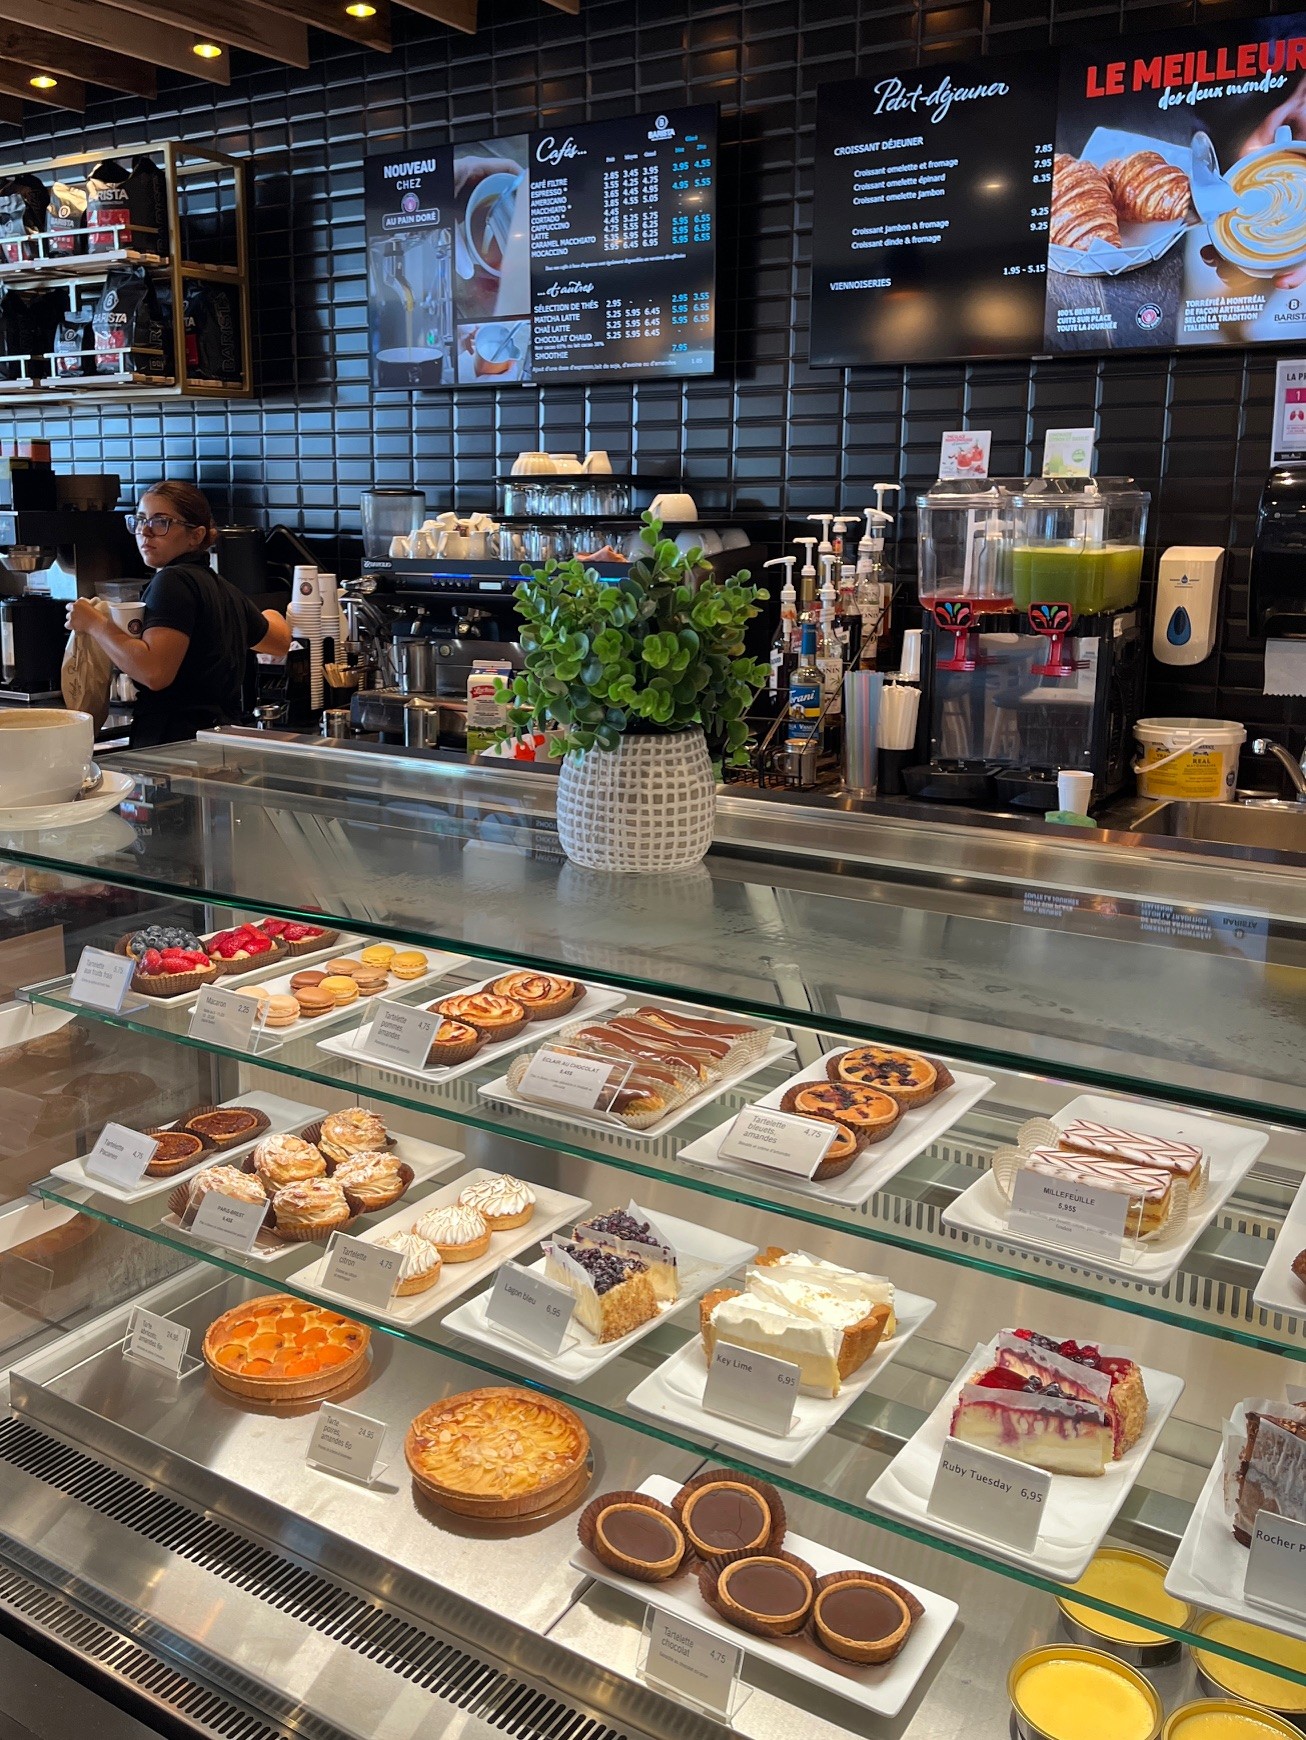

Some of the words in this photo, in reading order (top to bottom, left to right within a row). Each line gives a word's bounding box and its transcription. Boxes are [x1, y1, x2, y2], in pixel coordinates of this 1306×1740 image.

[1086, 62, 1126, 98] LE
[1132, 37, 1306, 92] MEILLEUR
[1158, 86, 1186, 110] des
[1186, 82, 1223, 106] deux
[1226, 68, 1288, 96] mondes
[834, 142, 880, 156] CROISSANT
[882, 136, 924, 150] DÉJEUNER
[383, 158, 436, 178] NOUVEAU
[531, 179, 546, 189] CAFÉ
[547, 178, 568, 188] FILTRE
[623, 169, 639, 178] 3.45
[642, 166, 659, 175] 3.95
[672, 162, 689, 172] 3.95
[853, 181, 885, 191] Croissant
[886, 178, 917, 188] omelette
[918, 173, 946, 185] épinard
[1034, 159, 1052, 169] 7.95
[854, 167, 886, 178] Croissant
[887, 163, 918, 174] omelette
[928, 159, 958, 169] fromage
[396, 178, 421, 190] CHEZ
[531, 188, 562, 198] ESPRESSO
[623, 178, 639, 186] 4.25
[642, 176, 659, 184] 4.75
[853, 195, 885, 205] Croissant
[885, 192, 917, 202] omelette
[917, 189, 945, 199] jambon
[1033, 174, 1051, 183] 8.35
[531, 197, 567, 207] AMERICANO
[623, 187, 639, 196] 4.45
[642, 185, 659, 193] 4.95
[531, 206, 566, 216] MACCHIATO
[386, 218, 397, 226] AU
[398, 215, 414, 225] PAIN
[416, 212, 436, 222] DORÉ
[531, 215, 560, 224] CORTADO
[852, 226, 883, 236] Croissant
[884, 224, 911, 234] jambon
[919, 220, 949, 229] fromage
[1031, 207, 1049, 216] 9.25
[531, 222, 570, 232] CAPPUCCINO
[531, 232, 549, 240] LATTE
[531, 240, 559, 249] CARAMEL
[560, 236, 596, 246] MACCHIATO
[851, 240, 883, 249] Croissant
[884, 238, 903, 246] dinde
[911, 235, 941, 244] fromage
[1030, 222, 1048, 231] 9.25
[531, 248, 568, 258] MOCACCINO
[642, 238, 659, 247] 6.95
[829, 277, 892, 291] VIENNOISERIES
[1003, 266, 1020, 275] 1.95
[1028, 264, 1046, 273] 5.15
[534, 304, 569, 313] SÉLECTION
[581, 300, 599, 309] THÉS
[606, 299, 622, 308] 2.95
[672, 294, 688, 303] 2.95
[693, 292, 709, 300] 3.55
[1186, 298, 1219, 307] TORRÉFIÉ
[1220, 297, 1226, 306] À
[1227, 294, 1266, 305] MONTRÉAL
[534, 315, 560, 323] MATCHA
[606, 310, 622, 318] 5.25
[625, 309, 641, 317] 5.95
[644, 307, 660, 316] 6.45
[672, 305, 688, 314] 5.95
[1074, 307, 1100, 316] BEURRE
[1220, 304, 1263, 313] ARTISANALE
[93, 313, 127, 323] BARISTA
[606, 321, 622, 329] 5.25
[625, 319, 641, 328] 5.95
[644, 318, 660, 326] 6.45
[672, 316, 688, 325] 5.95
[1218, 313, 1258, 322] TRADITION
[1088, 321, 1117, 330] JOURNÉE
[1184, 323, 1219, 332] ITALIENNE
[534, 335, 568, 344] CHOCOLAT
[606, 331, 622, 339] 5.25
[625, 330, 641, 338] 5.95
[644, 329, 660, 337] 6.45
[535, 352, 568, 360] SMOOTHIE
[672, 343, 688, 352] 7.95
[1296, 390, 1300, 401] 1
[206, 997, 226, 1007] Macaron
[385, 1011, 407, 1024] Tartelette
[378, 1029, 400, 1040] amandes
[570, 1063, 600, 1073] CHOCOLAT
[753, 1115, 787, 1130] Tartelette
[743, 1131, 777, 1144] amandes
[1043, 1187, 1095, 1206] MILLEFEUILLE
[339, 1257, 355, 1266] citron
[343, 1247, 367, 1261] Tartelette
[504, 1283, 522, 1297] Lagon
[523, 1292, 536, 1305] bleu
[717, 1354, 731, 1366] Key
[733, 1360, 752, 1372] Lime
[778, 1374, 796, 1386] 6,95
[328, 1416, 339, 1426] Tarte
[321, 1434, 344, 1446] amandes
[943, 1460, 967, 1477] Ruby
[970, 1470, 1012, 1493] Tuesday
[1021, 1488, 1043, 1503] 6,95
[1256, 1530, 1296, 1550] Rocher
[664, 1626, 694, 1648] Tartelette
[661, 1638, 690, 1657] chocolat
